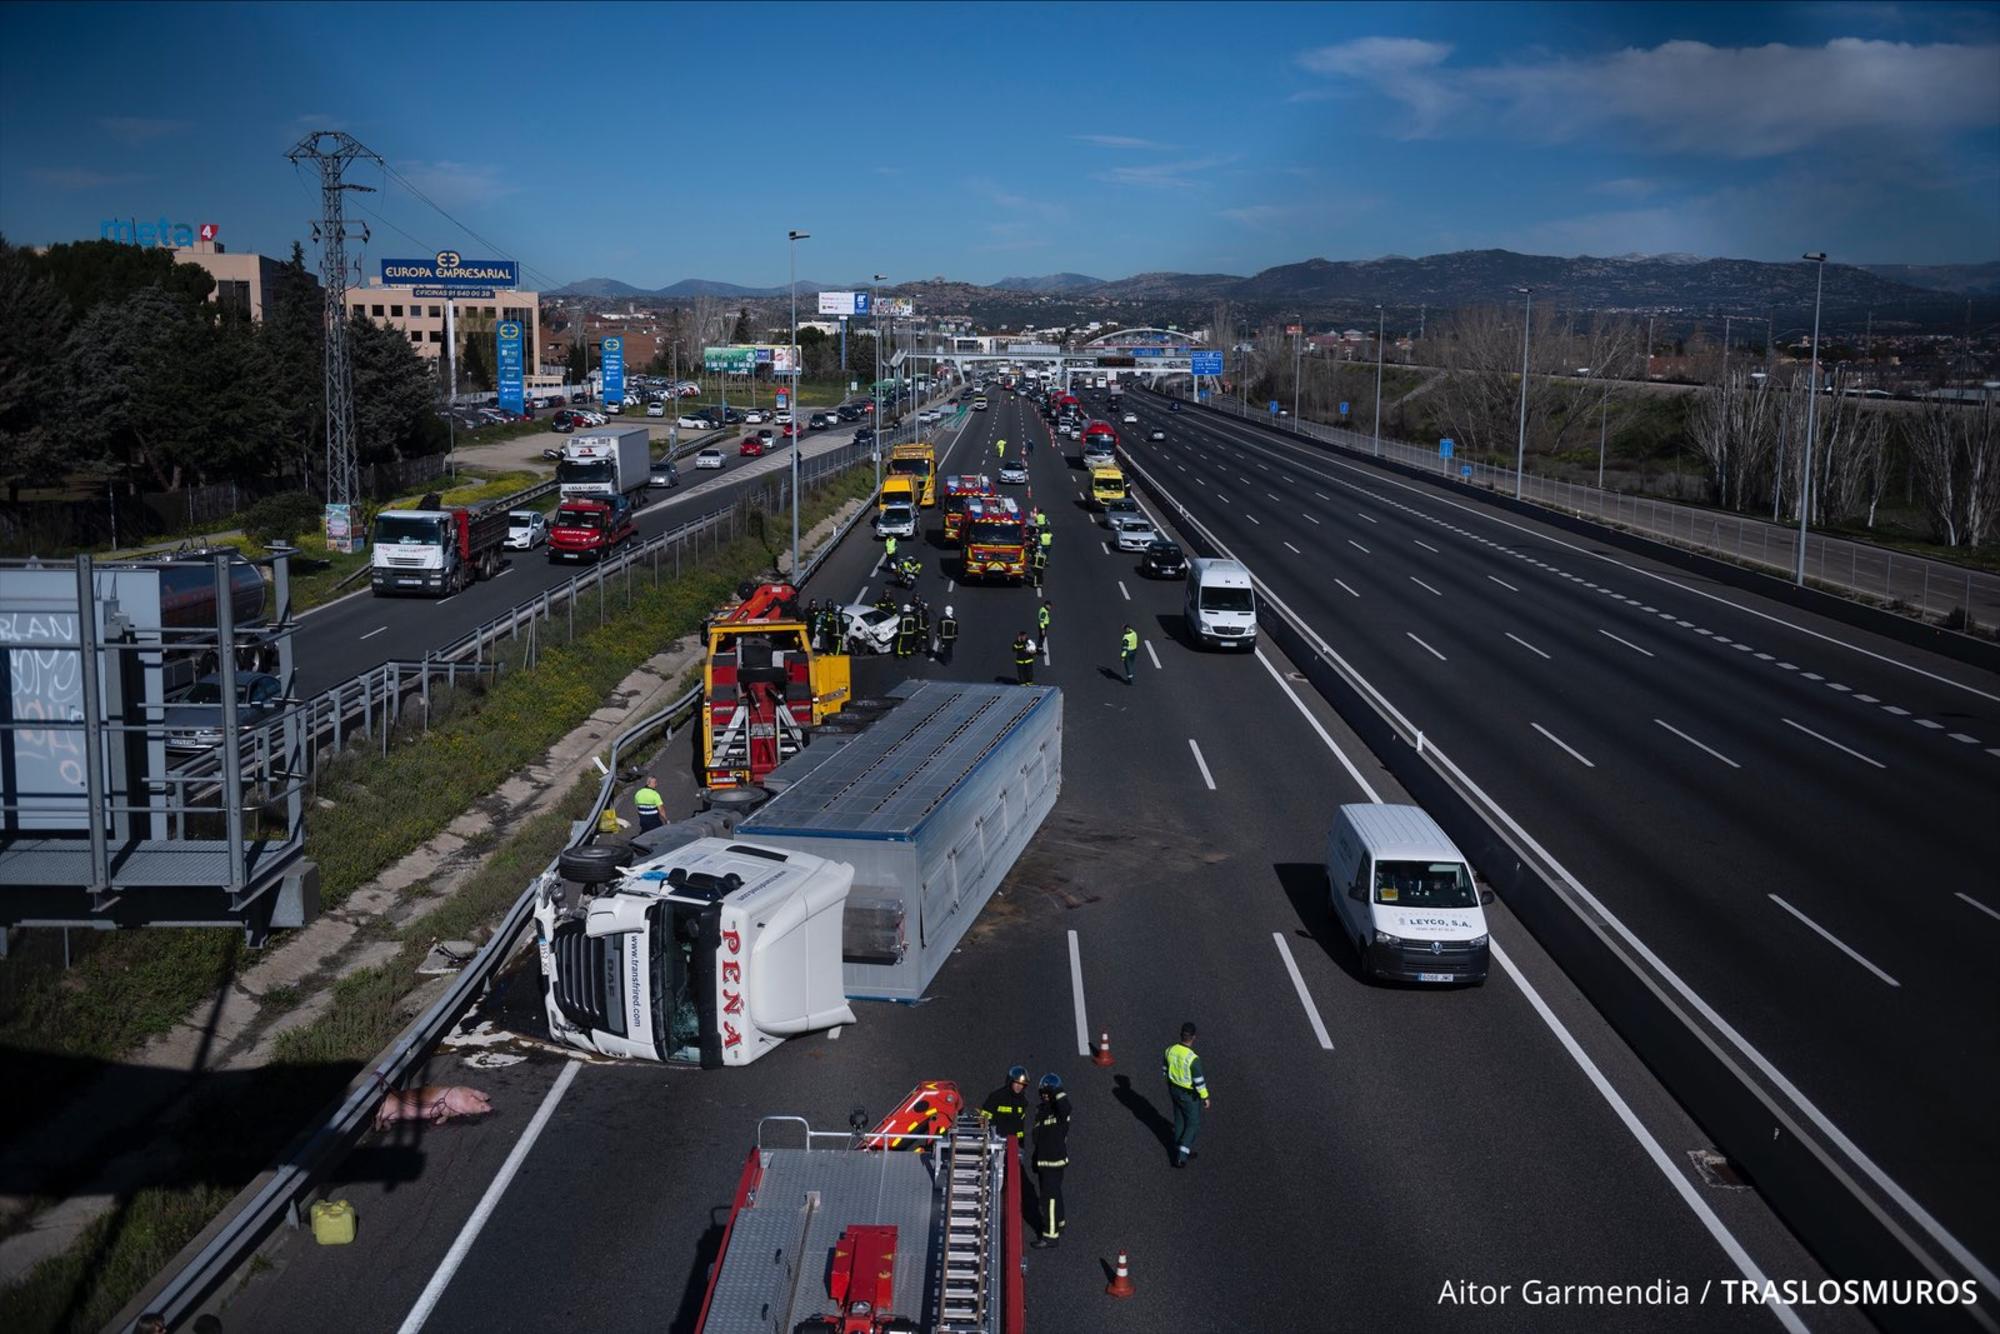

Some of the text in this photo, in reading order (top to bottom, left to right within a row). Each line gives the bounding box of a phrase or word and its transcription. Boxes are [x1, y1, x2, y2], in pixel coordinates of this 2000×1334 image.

[101, 217, 193, 247] meta
[385, 266, 512, 280] EUROPA EMPRESARIAL
[1409, 918, 1473, 928] LEYCO, S.A.
[721, 929, 745, 1049] PEÑA
